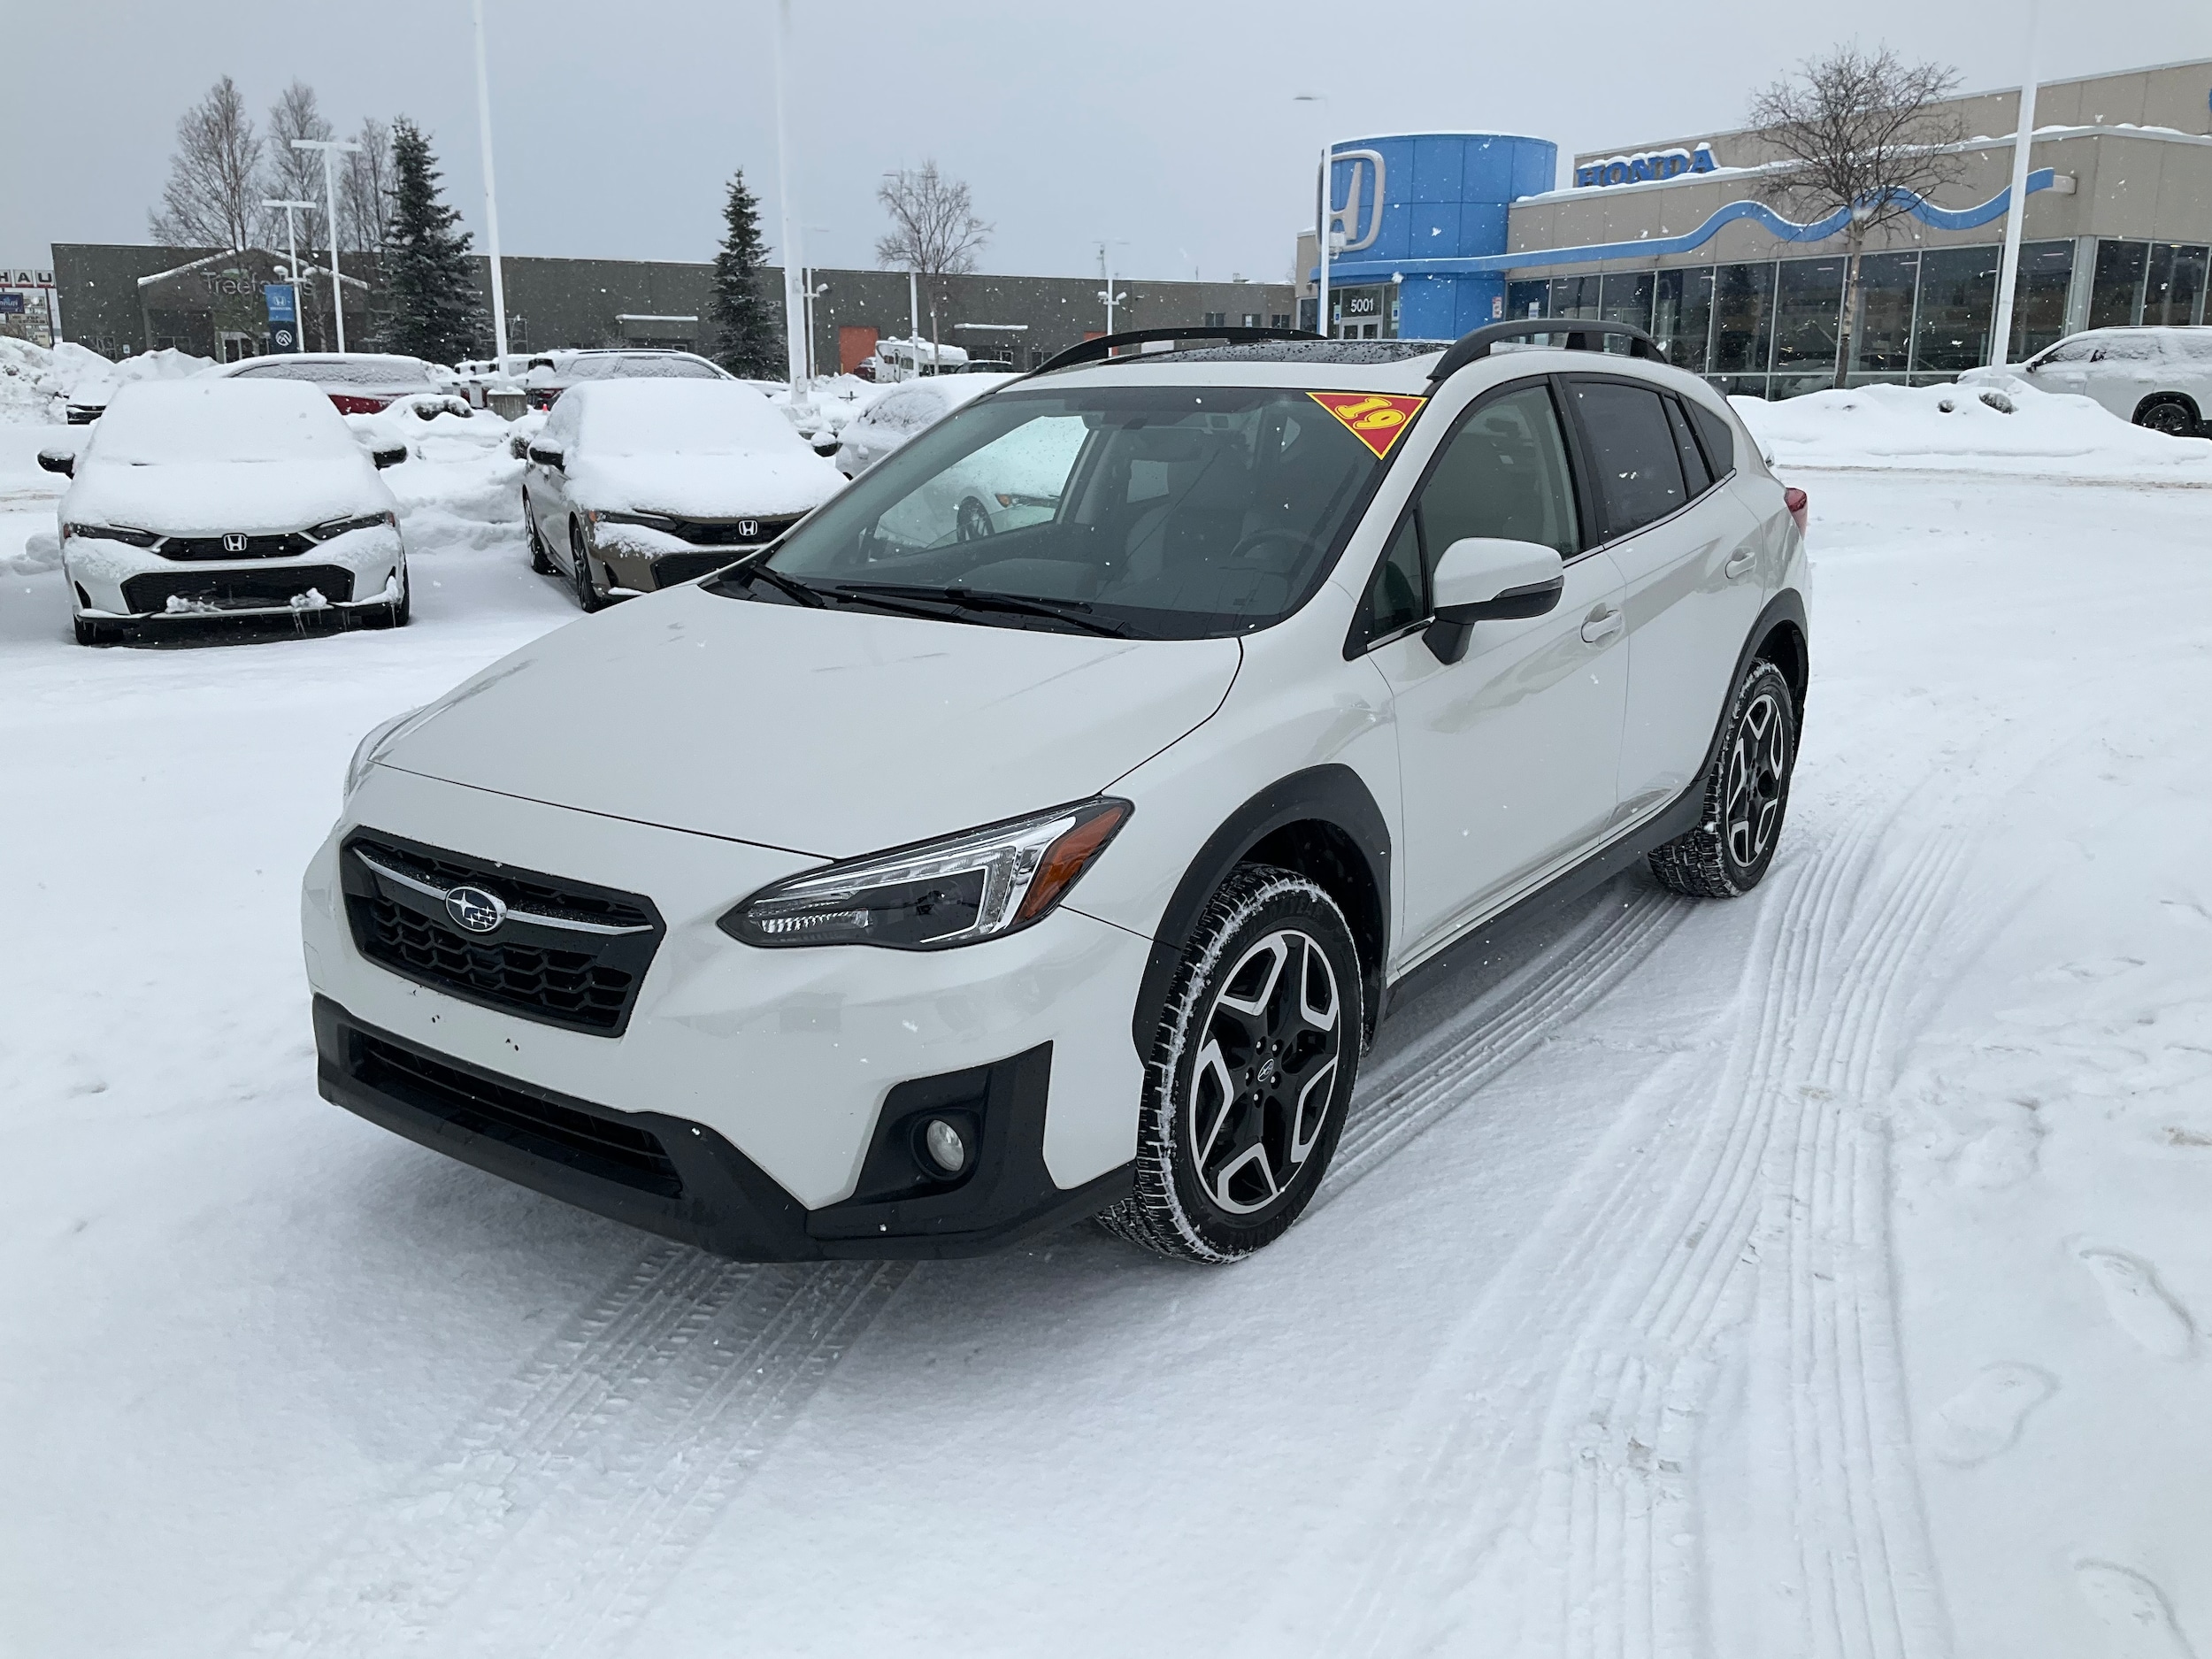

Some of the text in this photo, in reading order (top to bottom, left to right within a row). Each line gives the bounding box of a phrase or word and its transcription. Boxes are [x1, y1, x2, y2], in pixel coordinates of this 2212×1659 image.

[1576, 146, 1720, 188] HONDA
[1350, 298, 1374, 313] 5001
[1335, 396, 1406, 430] 19
